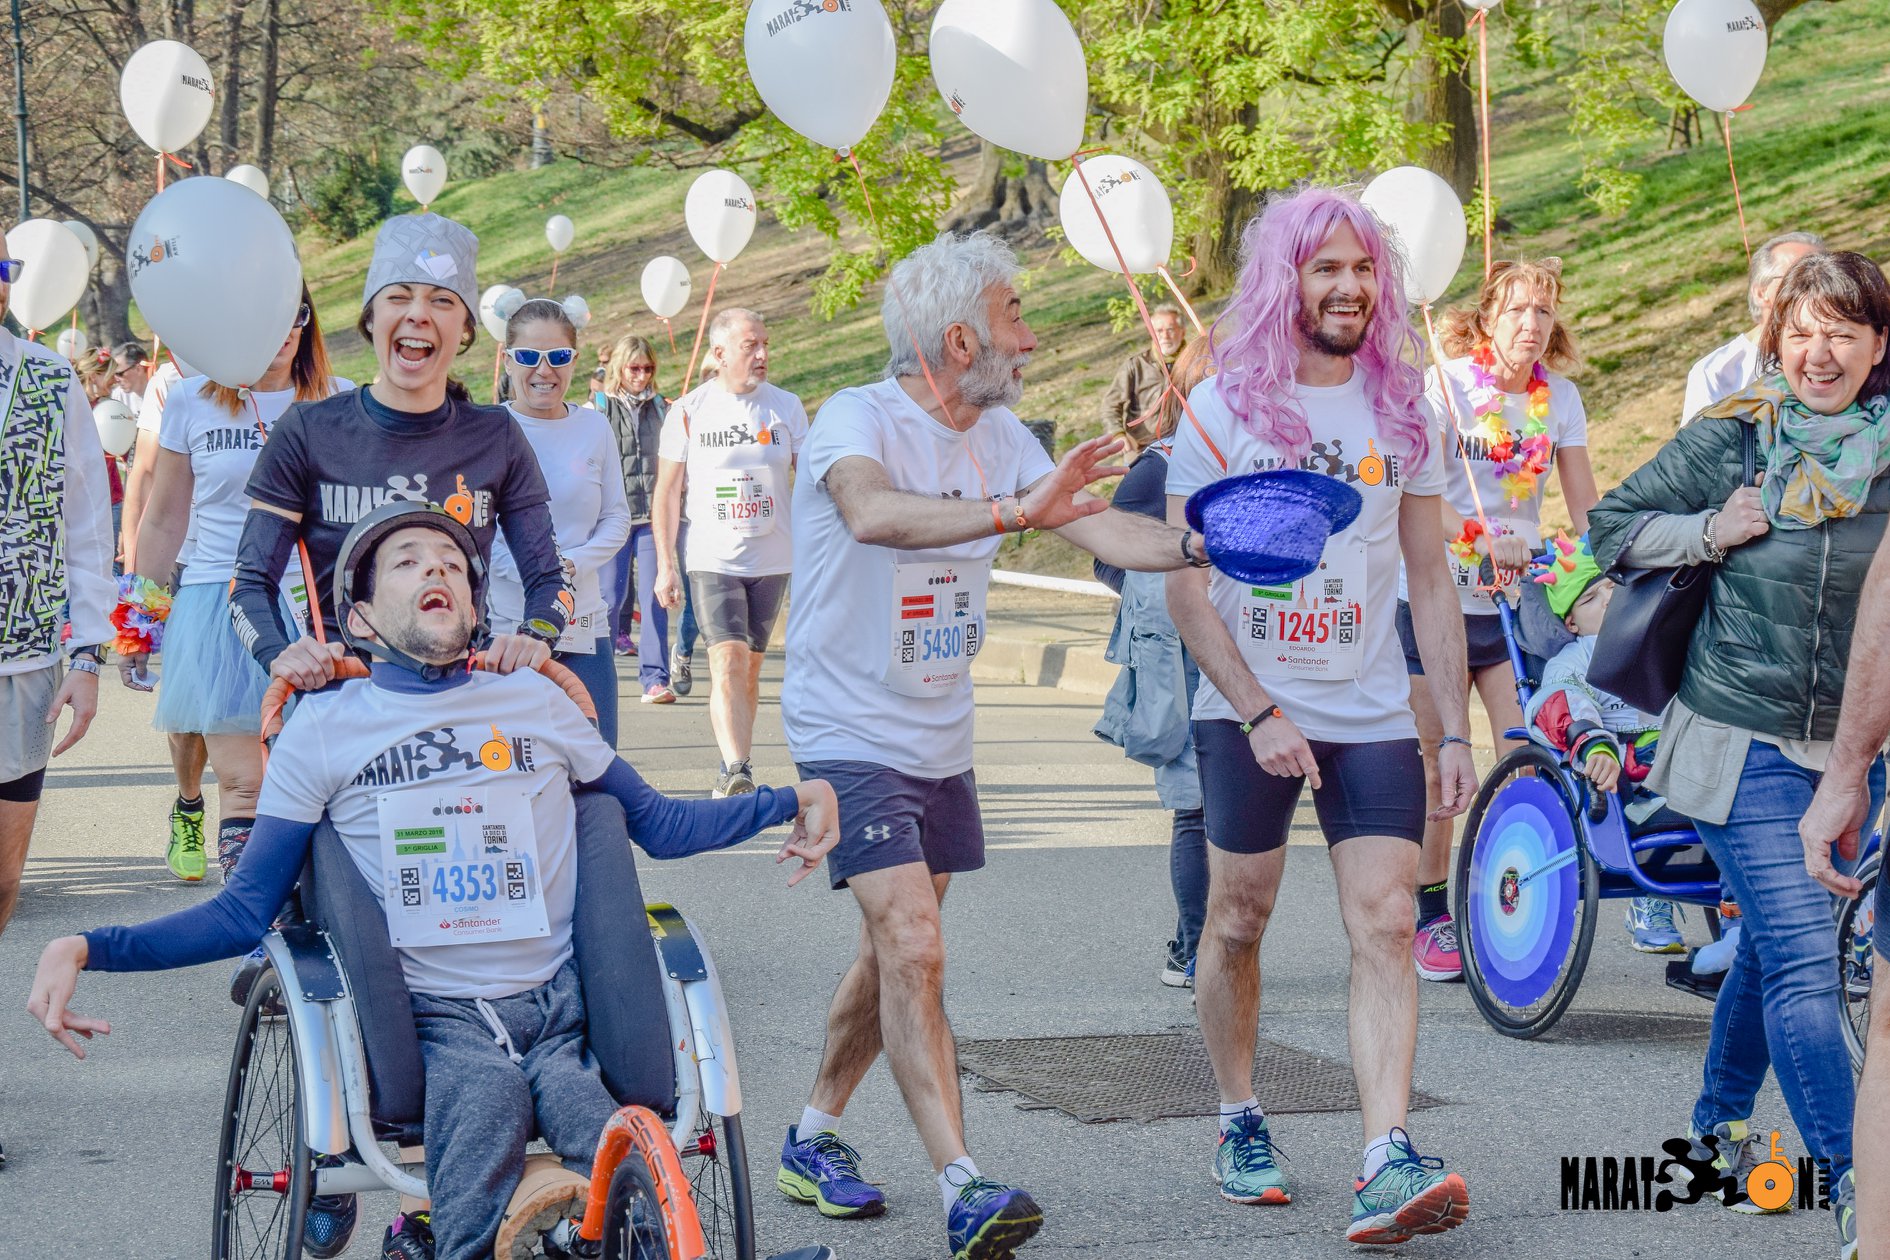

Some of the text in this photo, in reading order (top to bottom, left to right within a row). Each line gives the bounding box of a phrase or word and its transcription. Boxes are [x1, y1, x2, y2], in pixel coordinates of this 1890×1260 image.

[731, 502, 758, 519] 1259
[1324, 587, 1343, 596] TORINO
[1278, 611, 1330, 643] 1245
[922, 625, 961, 661] 5430
[1288, 656, 1330, 666] Santander
[405, 829, 428, 837] MARZO
[483, 835, 508, 845] TORINO
[432, 863, 497, 903] 4353
[452, 917, 501, 929] Santander
[453, 927, 502, 936] Consumer Bank
